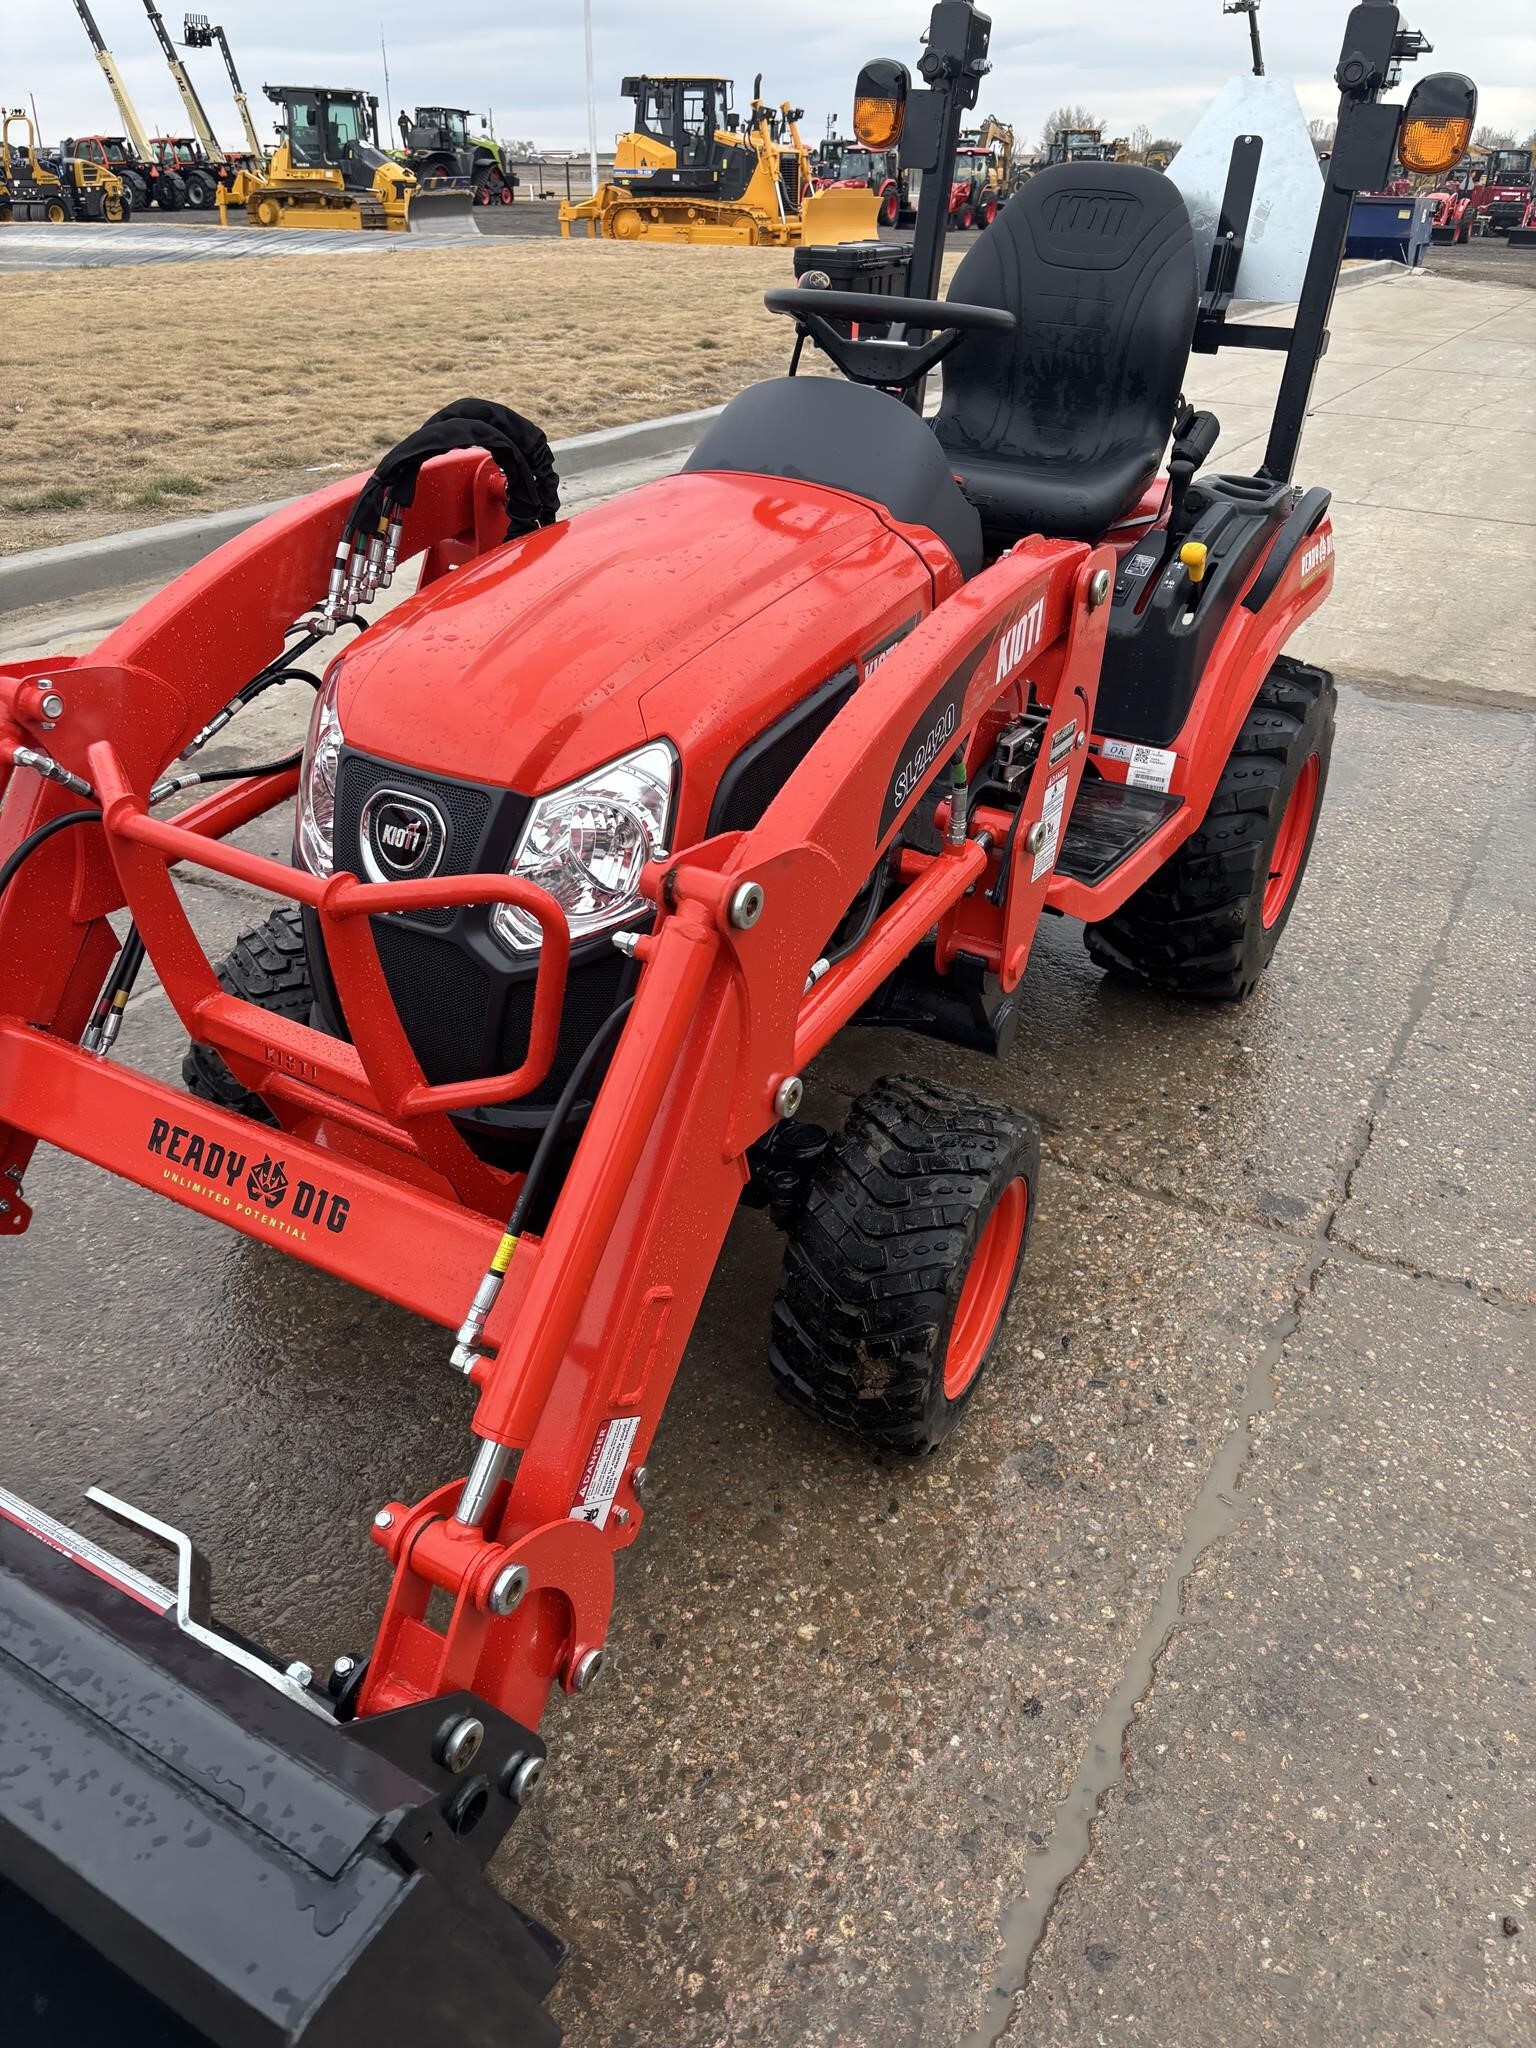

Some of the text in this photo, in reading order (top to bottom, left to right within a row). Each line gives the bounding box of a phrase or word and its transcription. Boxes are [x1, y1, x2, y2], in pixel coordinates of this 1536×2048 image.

[103, 66, 115, 85] JLG
[175, 75, 188, 92] JLG
[996, 596, 1045, 685] KIOTI
[894, 703, 955, 808] SL2420
[1110, 745, 1127, 756] OK
[382, 820, 421, 852] KIOTI
[147, 1117, 351, 1234] READY DIG
[163, 1169, 307, 1241] UNLIMITED POTENTIAL
[583, 1429, 607, 1485] DANGER
